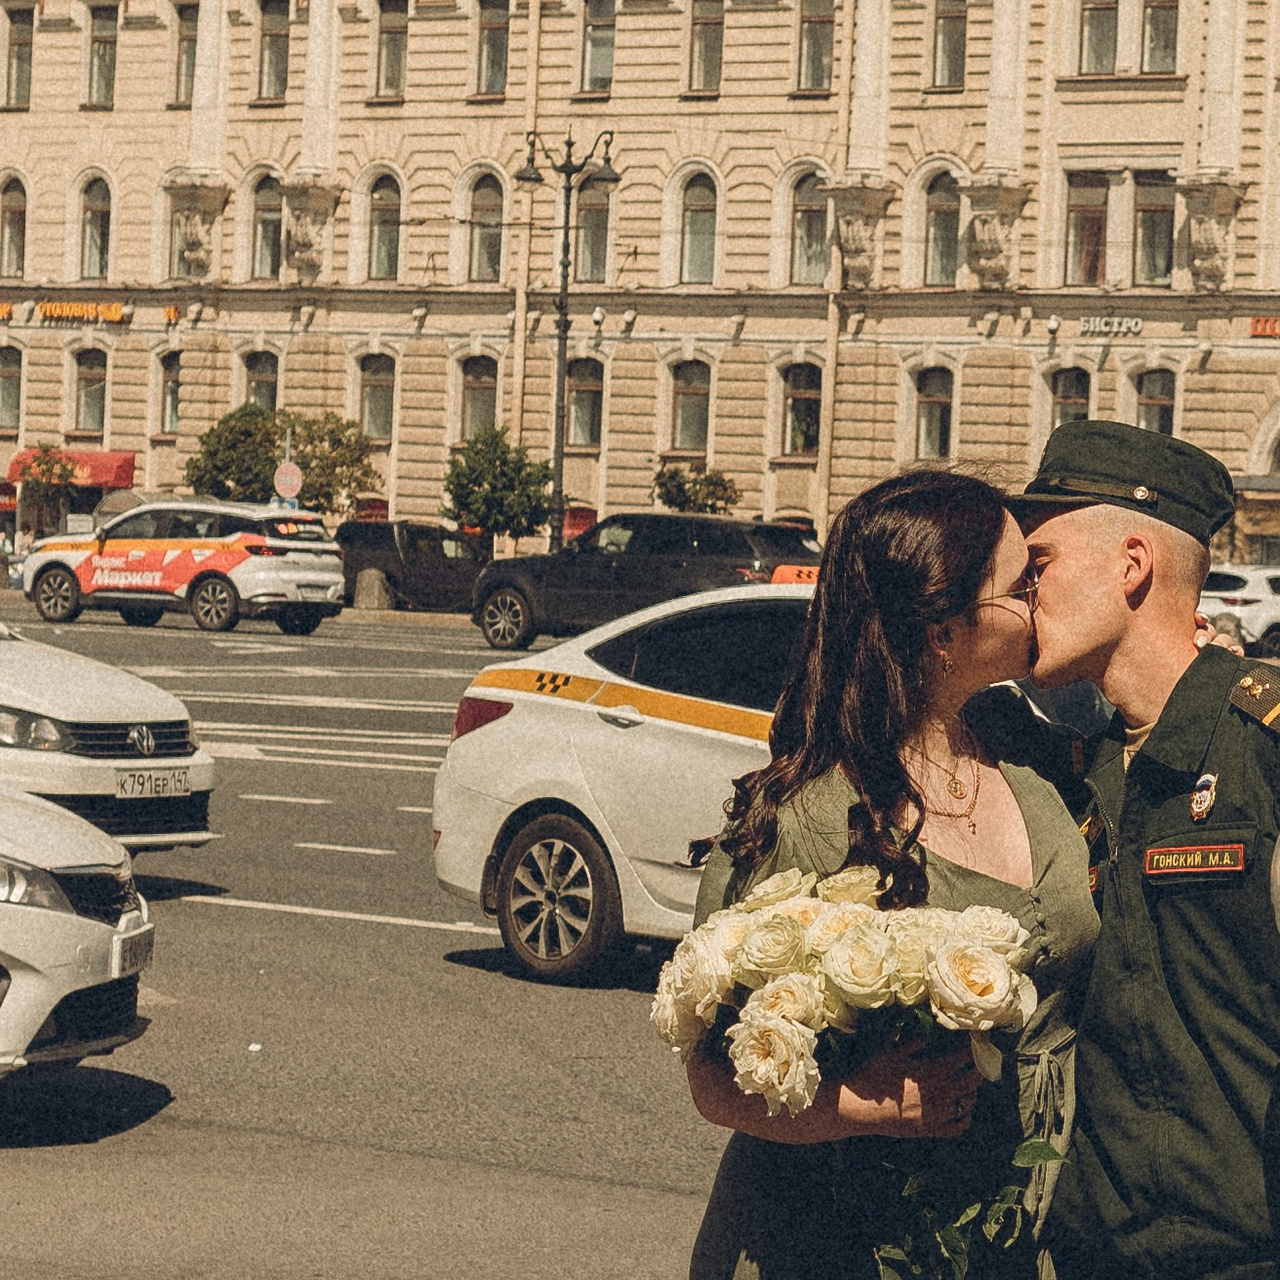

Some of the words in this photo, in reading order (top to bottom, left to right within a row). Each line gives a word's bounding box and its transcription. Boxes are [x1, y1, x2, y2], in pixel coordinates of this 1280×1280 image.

[1080, 316, 1143, 333] БИСТРО
[91, 568, 164, 587] Маркет
[1153, 851, 1202, 868] ГОНСКИЙ
[1208, 852, 1234, 866] М.А.
